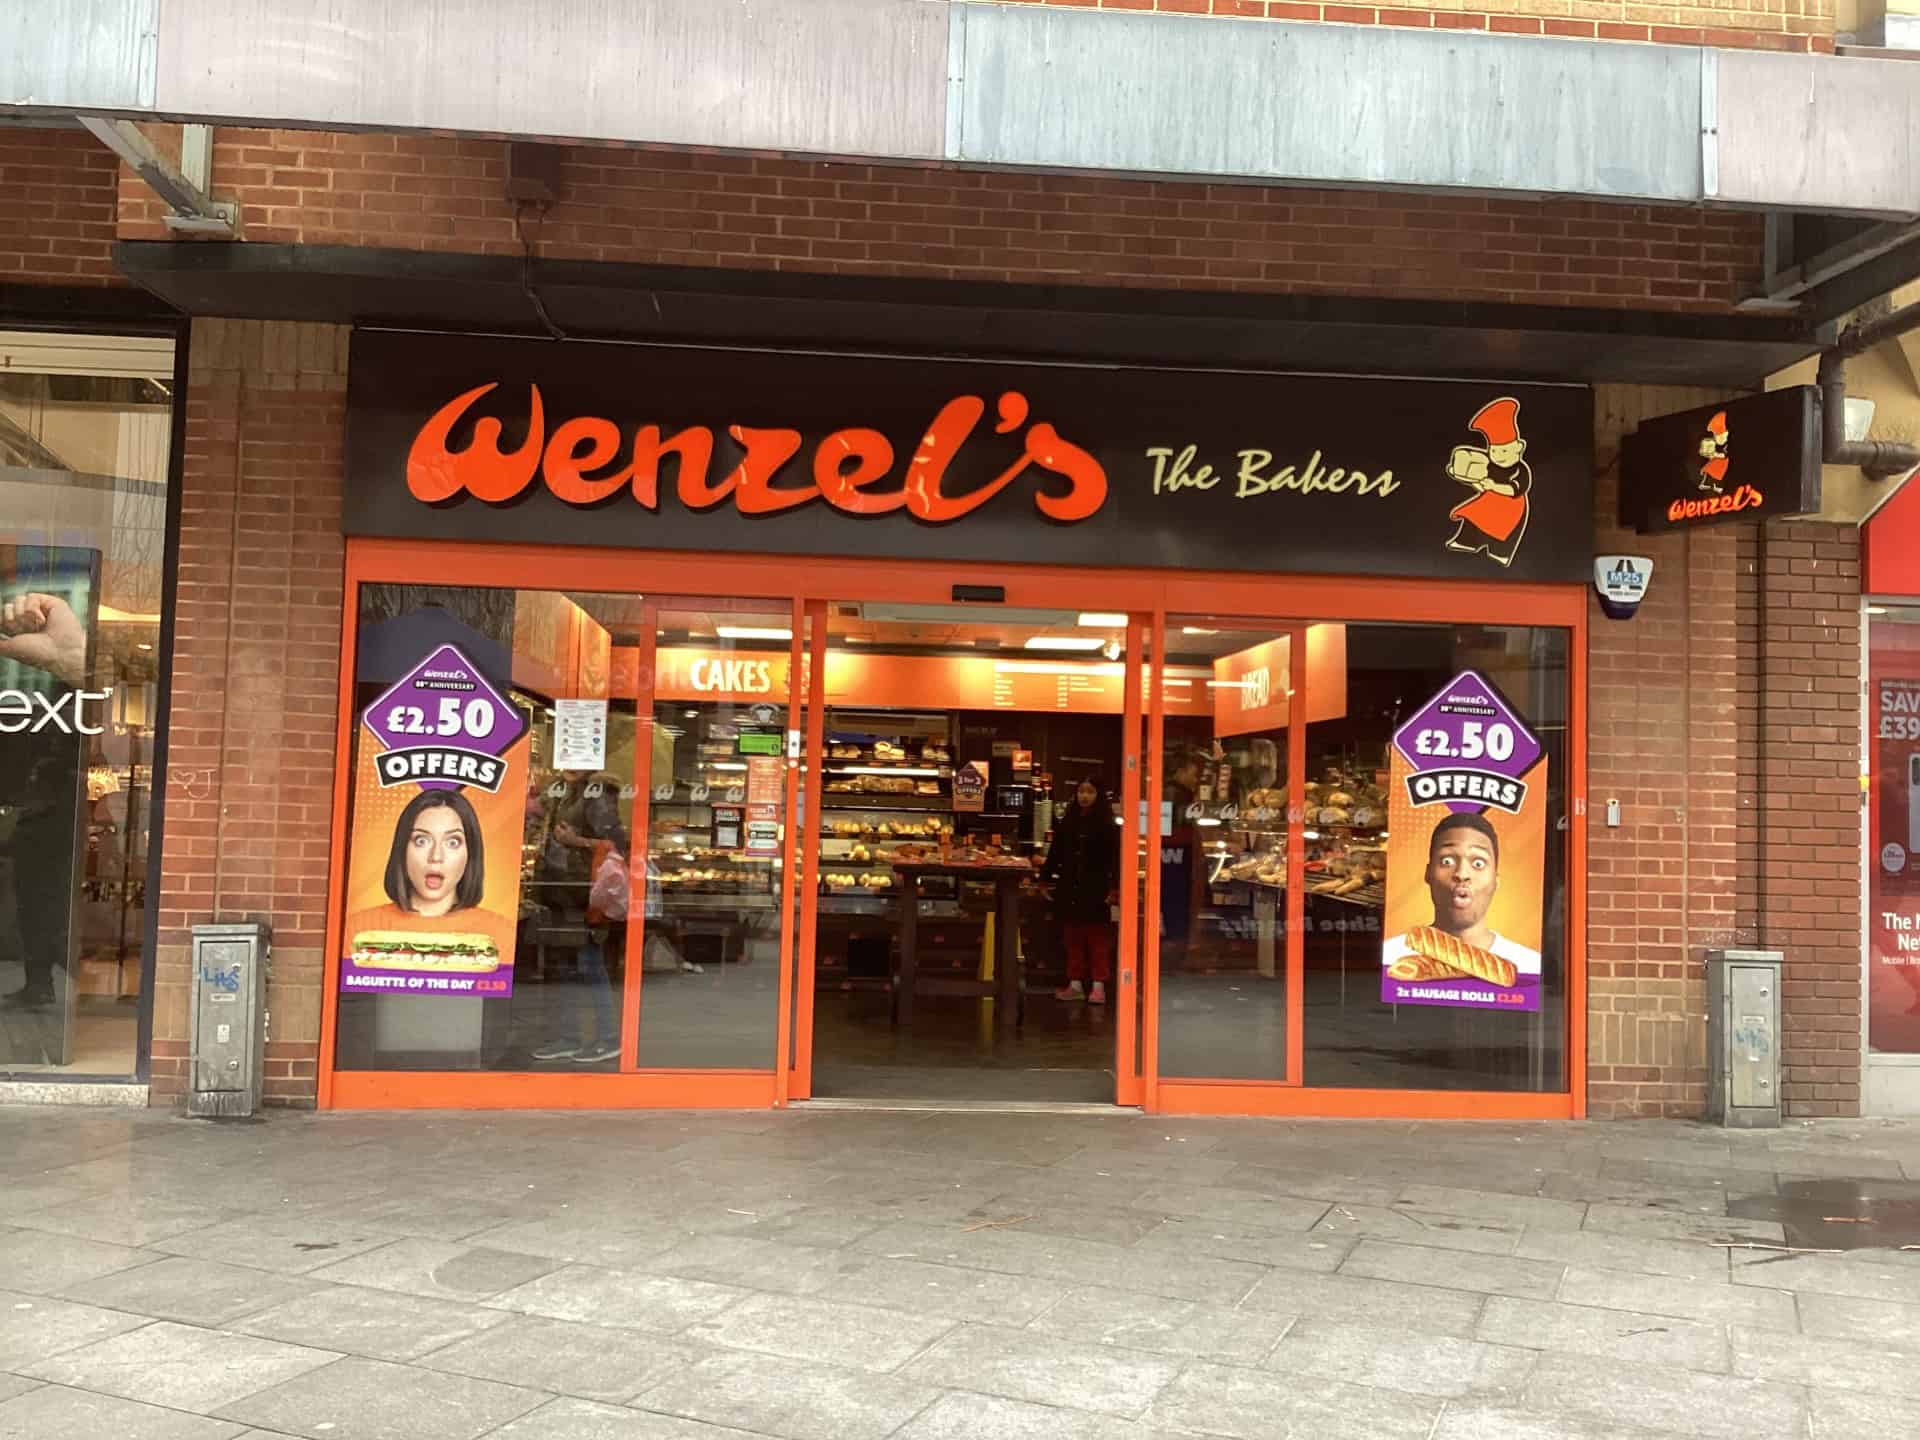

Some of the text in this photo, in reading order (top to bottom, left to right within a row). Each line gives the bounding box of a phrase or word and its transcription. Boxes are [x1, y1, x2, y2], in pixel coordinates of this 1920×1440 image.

[406, 381, 1108, 522] Wenzel's
[1146, 444, 1401, 498] The Bakers
[1668, 484, 1763, 521] Wenzel's
[691, 658, 770, 693] CAKES
[387, 698, 495, 738] £2.50
[1415, 722, 1514, 761] £2.50
[385, 753, 497, 783] OFFERS
[1415, 775, 1517, 805] OFFERS
[1882, 912, 1912, 930] The
[346, 975, 406, 987] BAGUETTE
[408, 978, 425, 988] OF
[427, 978, 448, 989] THE
[451, 979, 474, 990] DAY
[1411, 988, 1460, 1000] SAUSAGE
[1461, 991, 1495, 1003] ROLLS
